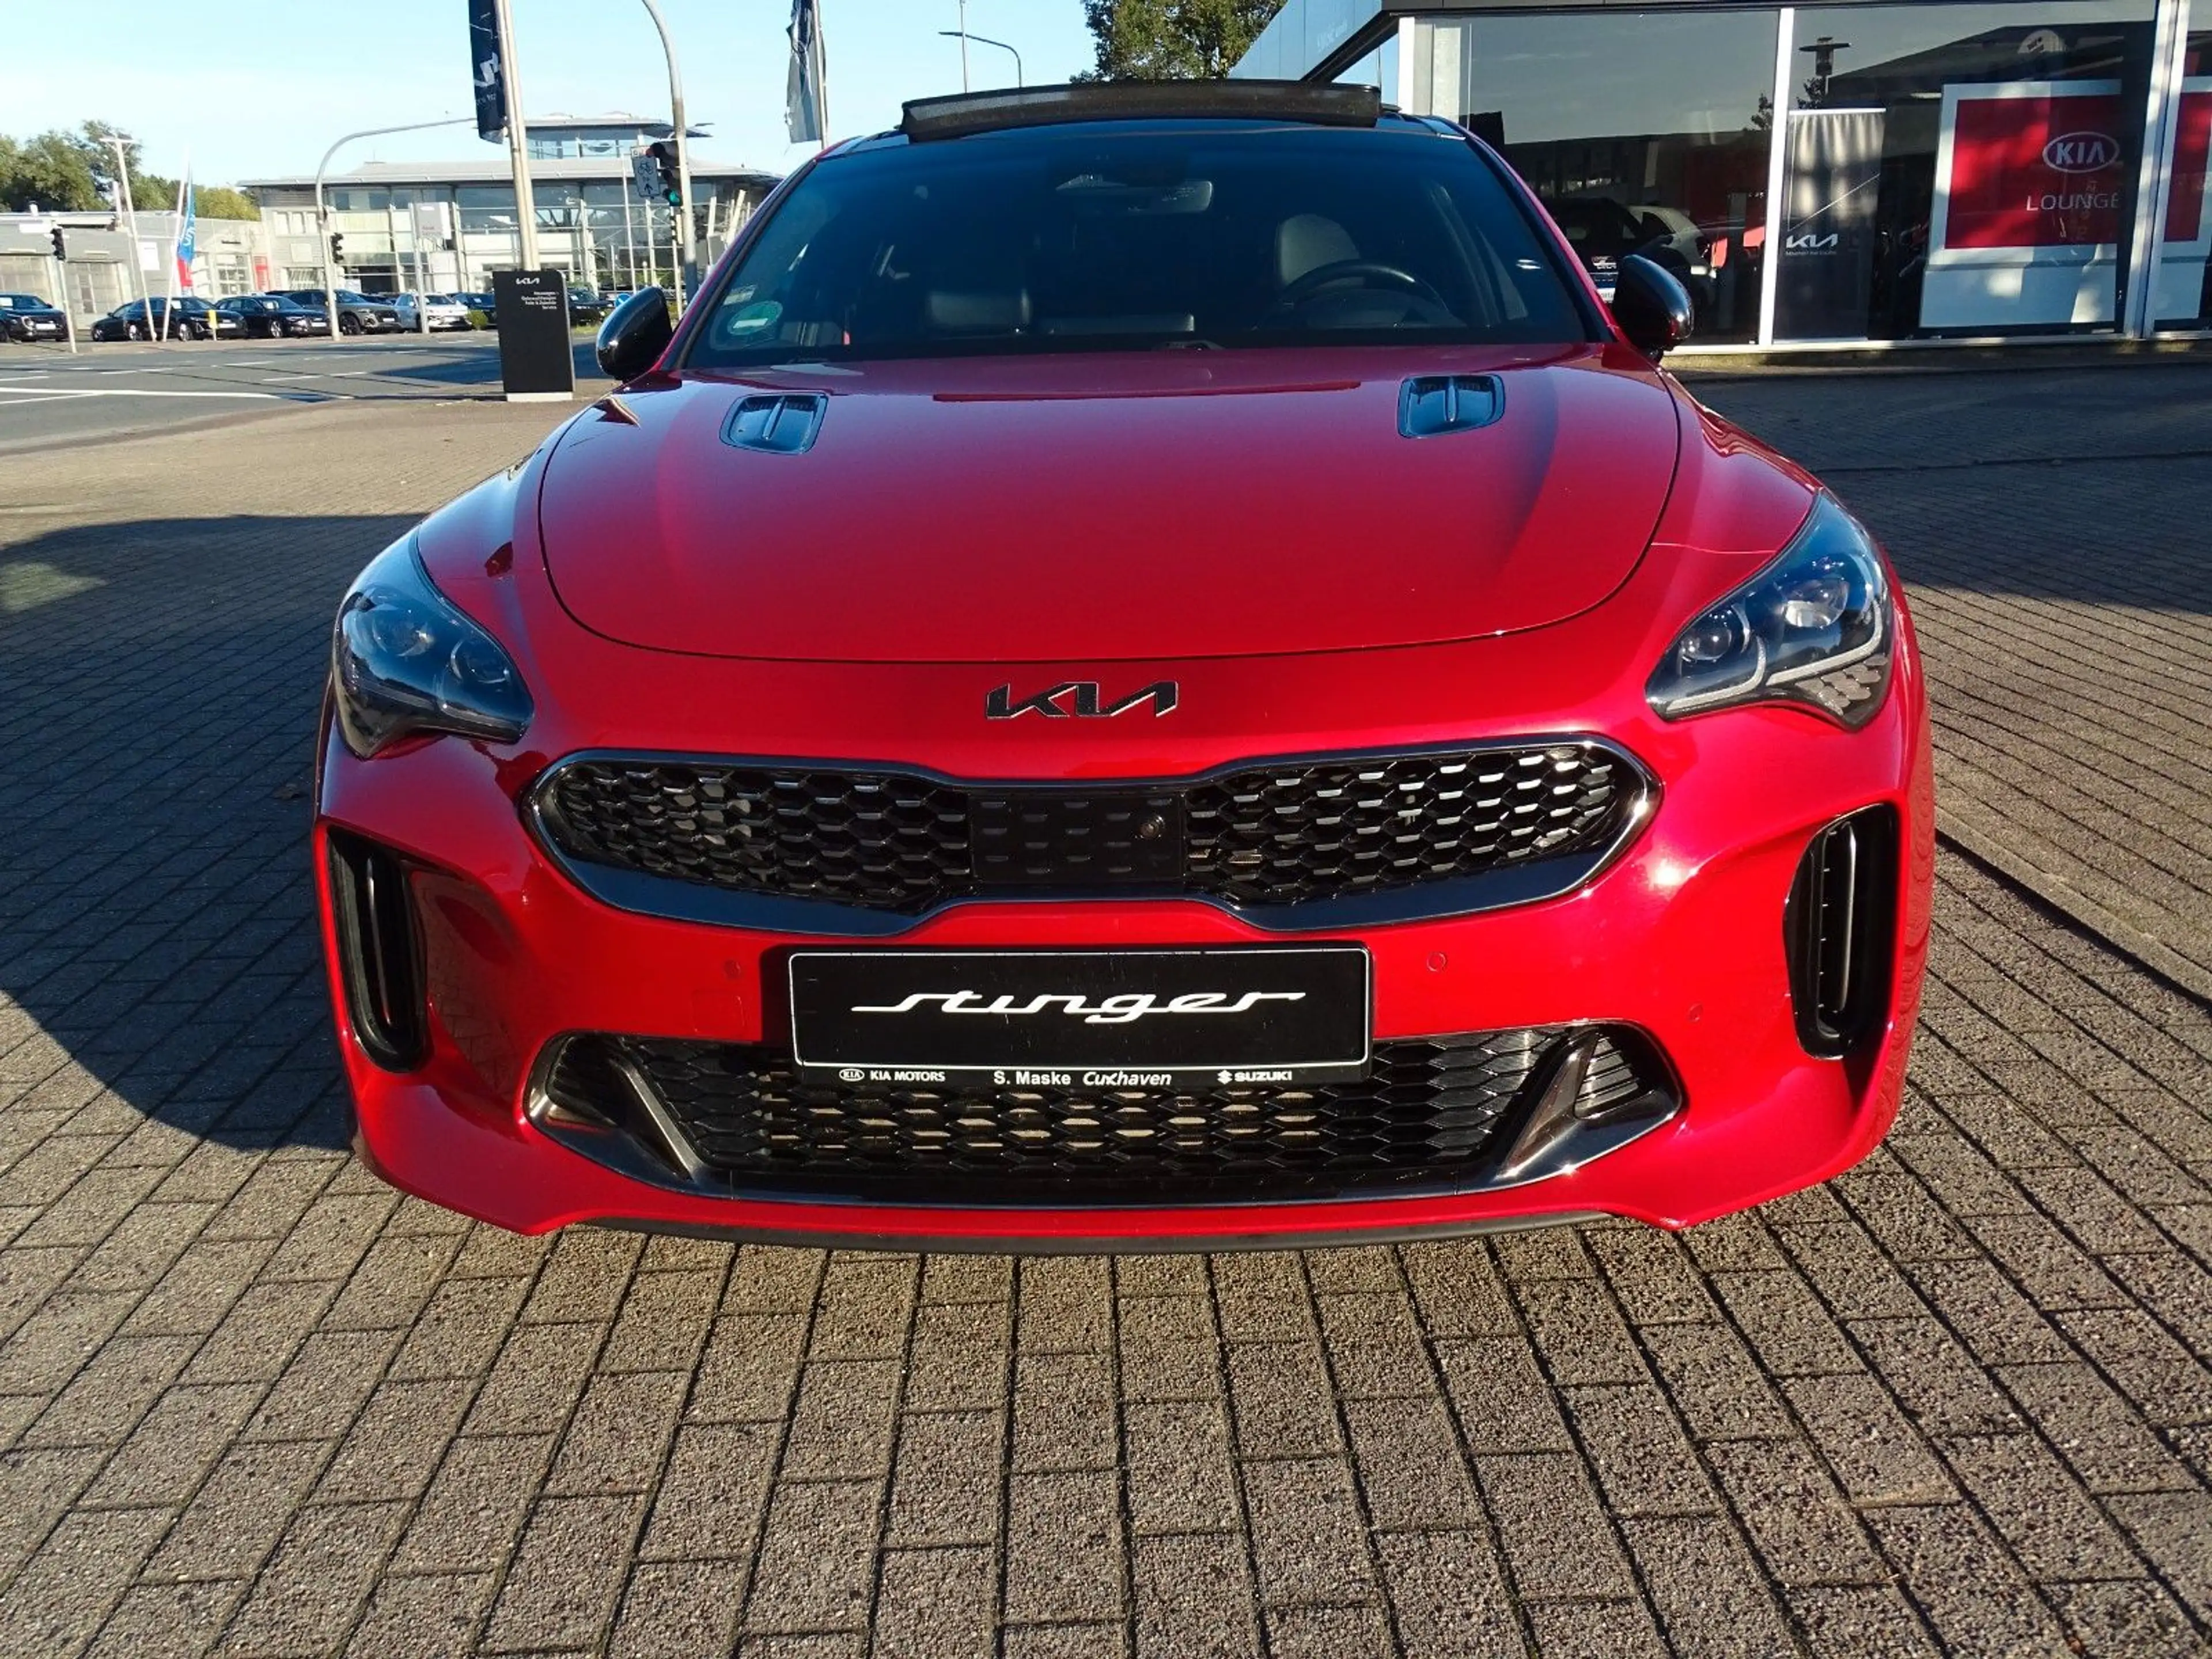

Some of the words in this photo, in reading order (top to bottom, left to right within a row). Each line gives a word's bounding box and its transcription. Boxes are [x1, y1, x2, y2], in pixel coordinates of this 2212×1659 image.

[2026, 192, 2120, 211] LOUNGE
[1786, 233, 1838, 248] KIA
[986, 680, 1179, 719] KIA
[870, 1070, 891, 1081] KIA
[895, 1071, 945, 1082] MOTORS
[994, 1071, 1010, 1085] S.
[1016, 1071, 1071, 1085] Maske
[1083, 1070, 1172, 1086] Cuxhaven
[1234, 1071, 1292, 1082] SUZUKI
